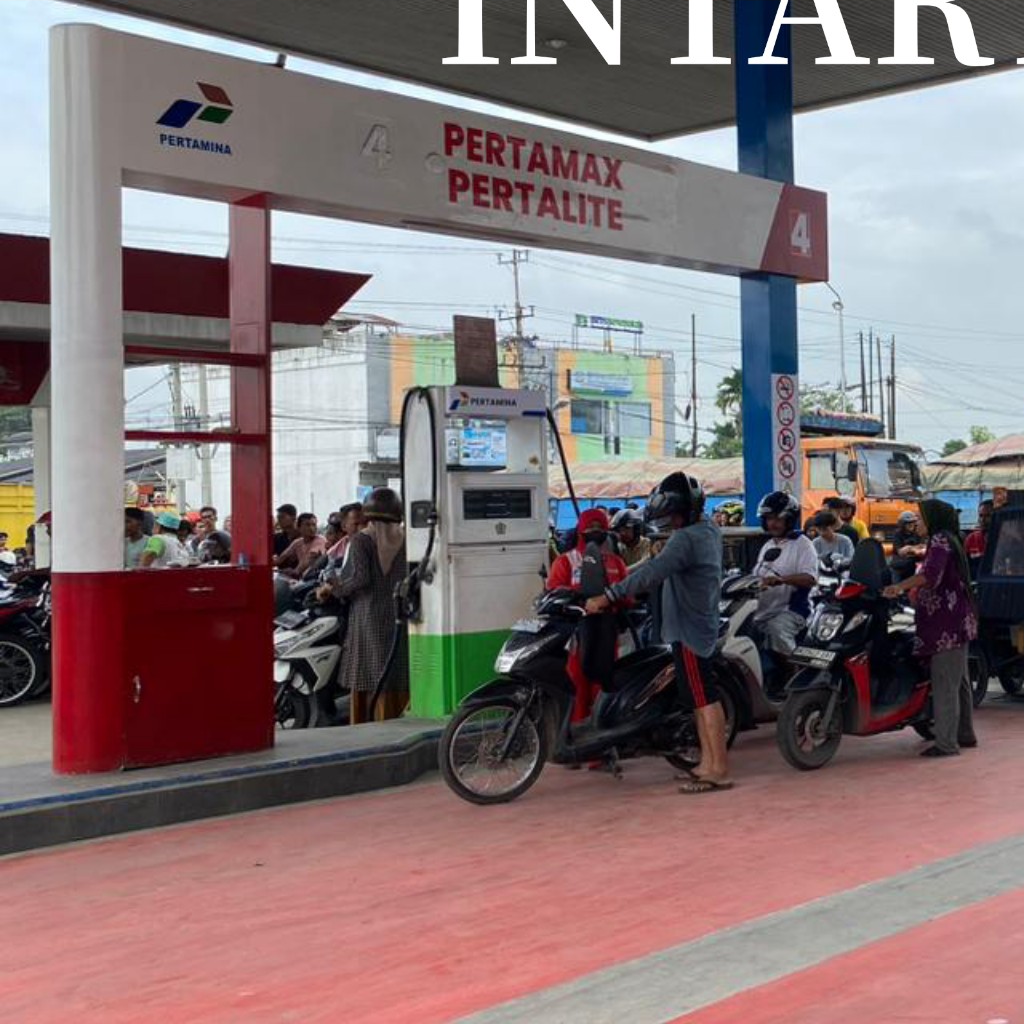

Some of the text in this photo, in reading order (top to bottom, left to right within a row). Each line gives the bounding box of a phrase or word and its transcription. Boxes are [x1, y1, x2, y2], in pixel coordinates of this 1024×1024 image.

[159, 133, 233, 156] PERTAMINA
[443, 122, 623, 191] PERTAMAX
[448, 169, 623, 231] PERTALITE
[790, 213, 812, 253] 4
[471, 397, 517, 407] PERTAMINA
